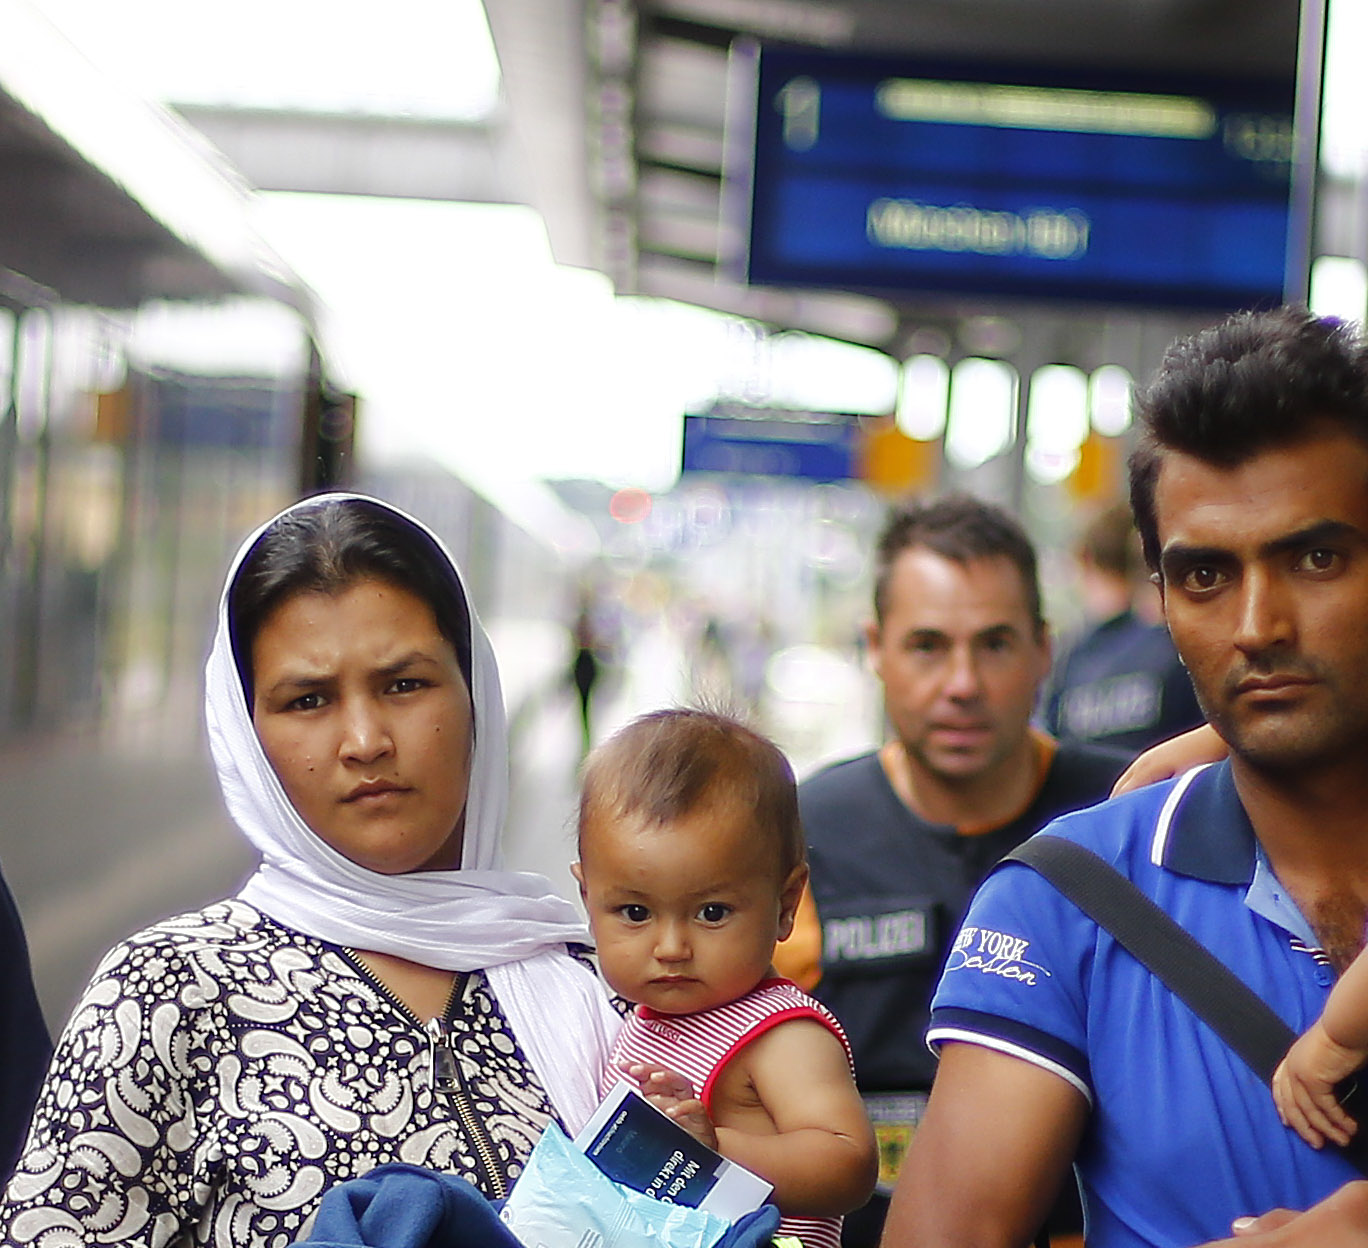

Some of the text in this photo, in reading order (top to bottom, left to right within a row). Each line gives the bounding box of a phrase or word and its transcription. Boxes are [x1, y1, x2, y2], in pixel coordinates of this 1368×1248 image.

[823, 911, 925, 962] POLIZEI
[978, 930, 1030, 960] YORK
[659, 1150, 684, 1179] direkt
[681, 1160, 700, 1179] Mit
[651, 1177, 667, 1189] in
[667, 1177, 686, 1196] den
